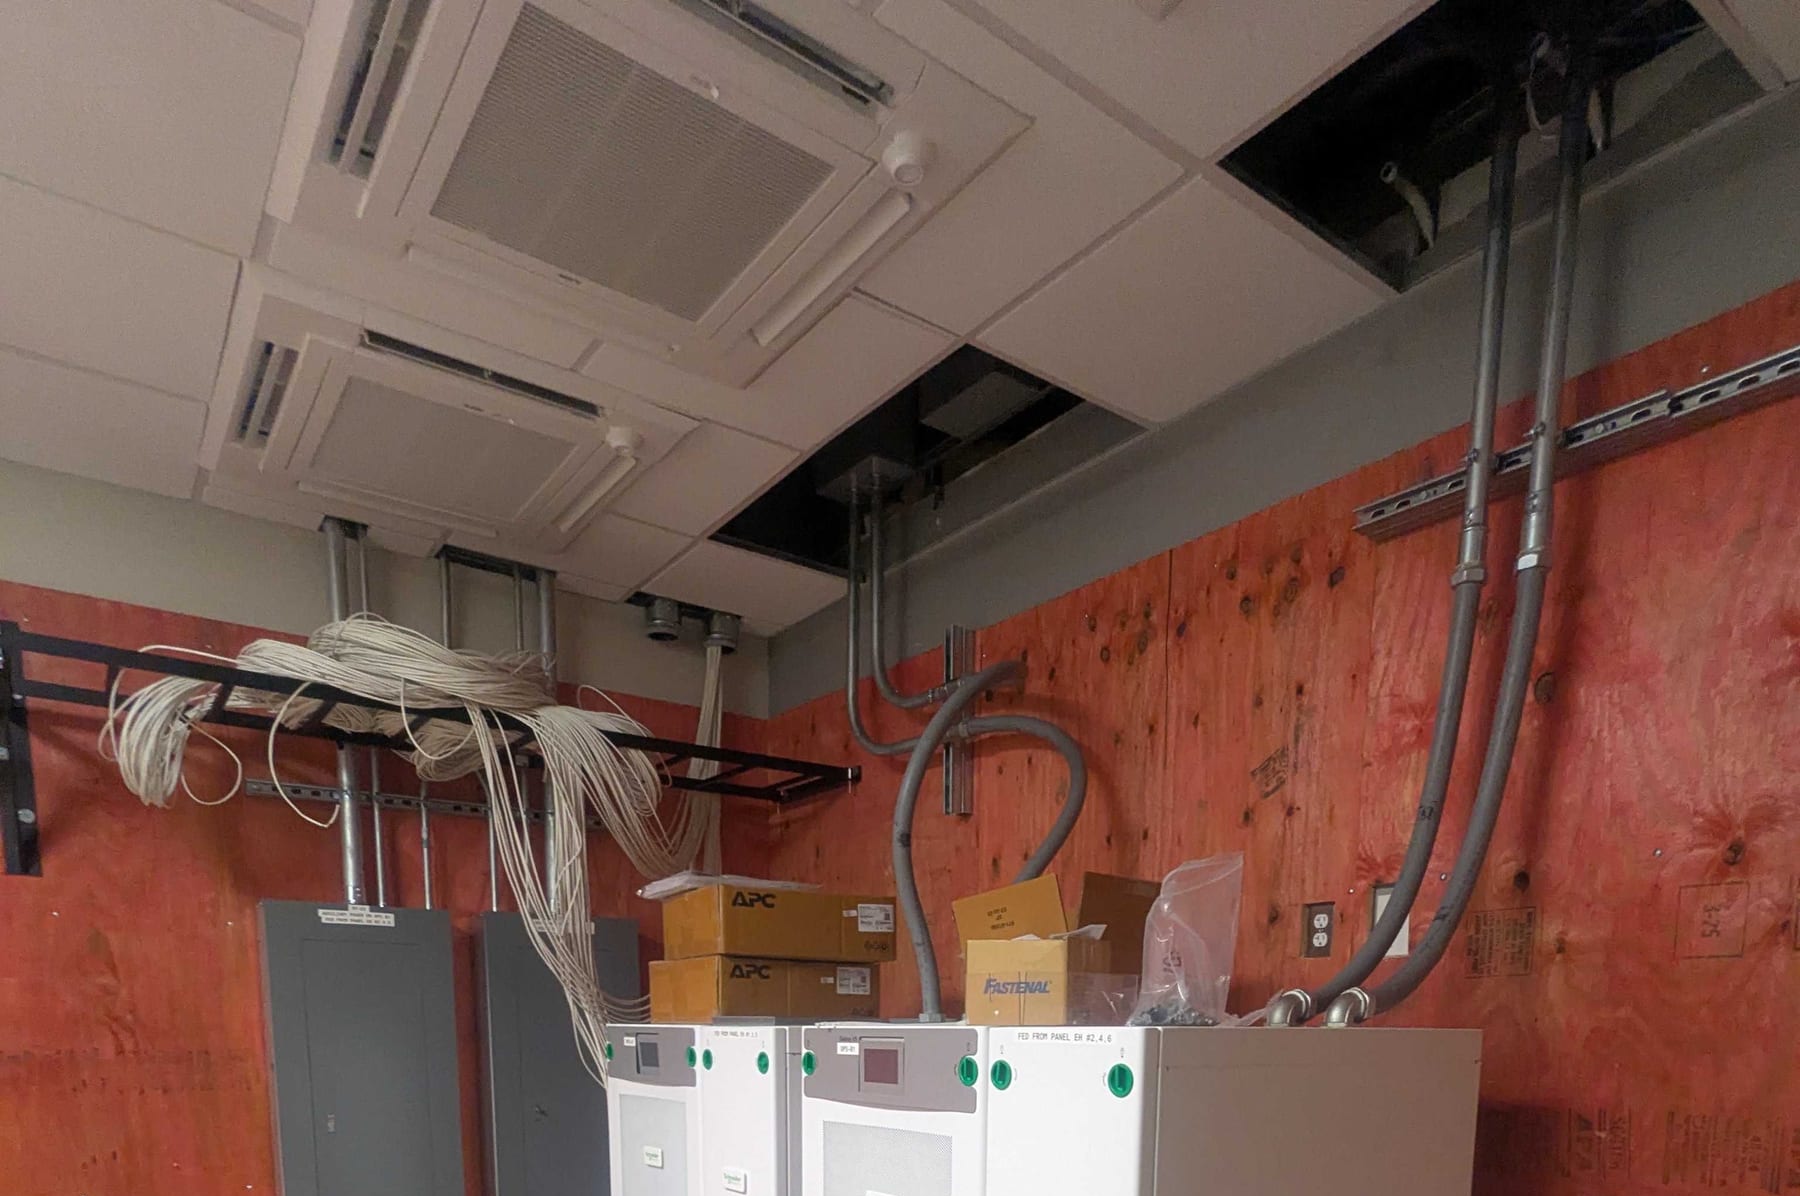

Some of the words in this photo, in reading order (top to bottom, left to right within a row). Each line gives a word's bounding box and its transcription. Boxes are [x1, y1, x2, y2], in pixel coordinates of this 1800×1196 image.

[732, 891, 776, 908] APC
[730, 963, 770, 979] APC
[983, 977, 1050, 994] FASTENAL
[1018, 1032, 1030, 1041] FED
[1032, 1032, 1048, 1041] FROM
[1051, 1032, 1071, 1042] PANEL
[1074, 1033, 1083, 1042] EH
